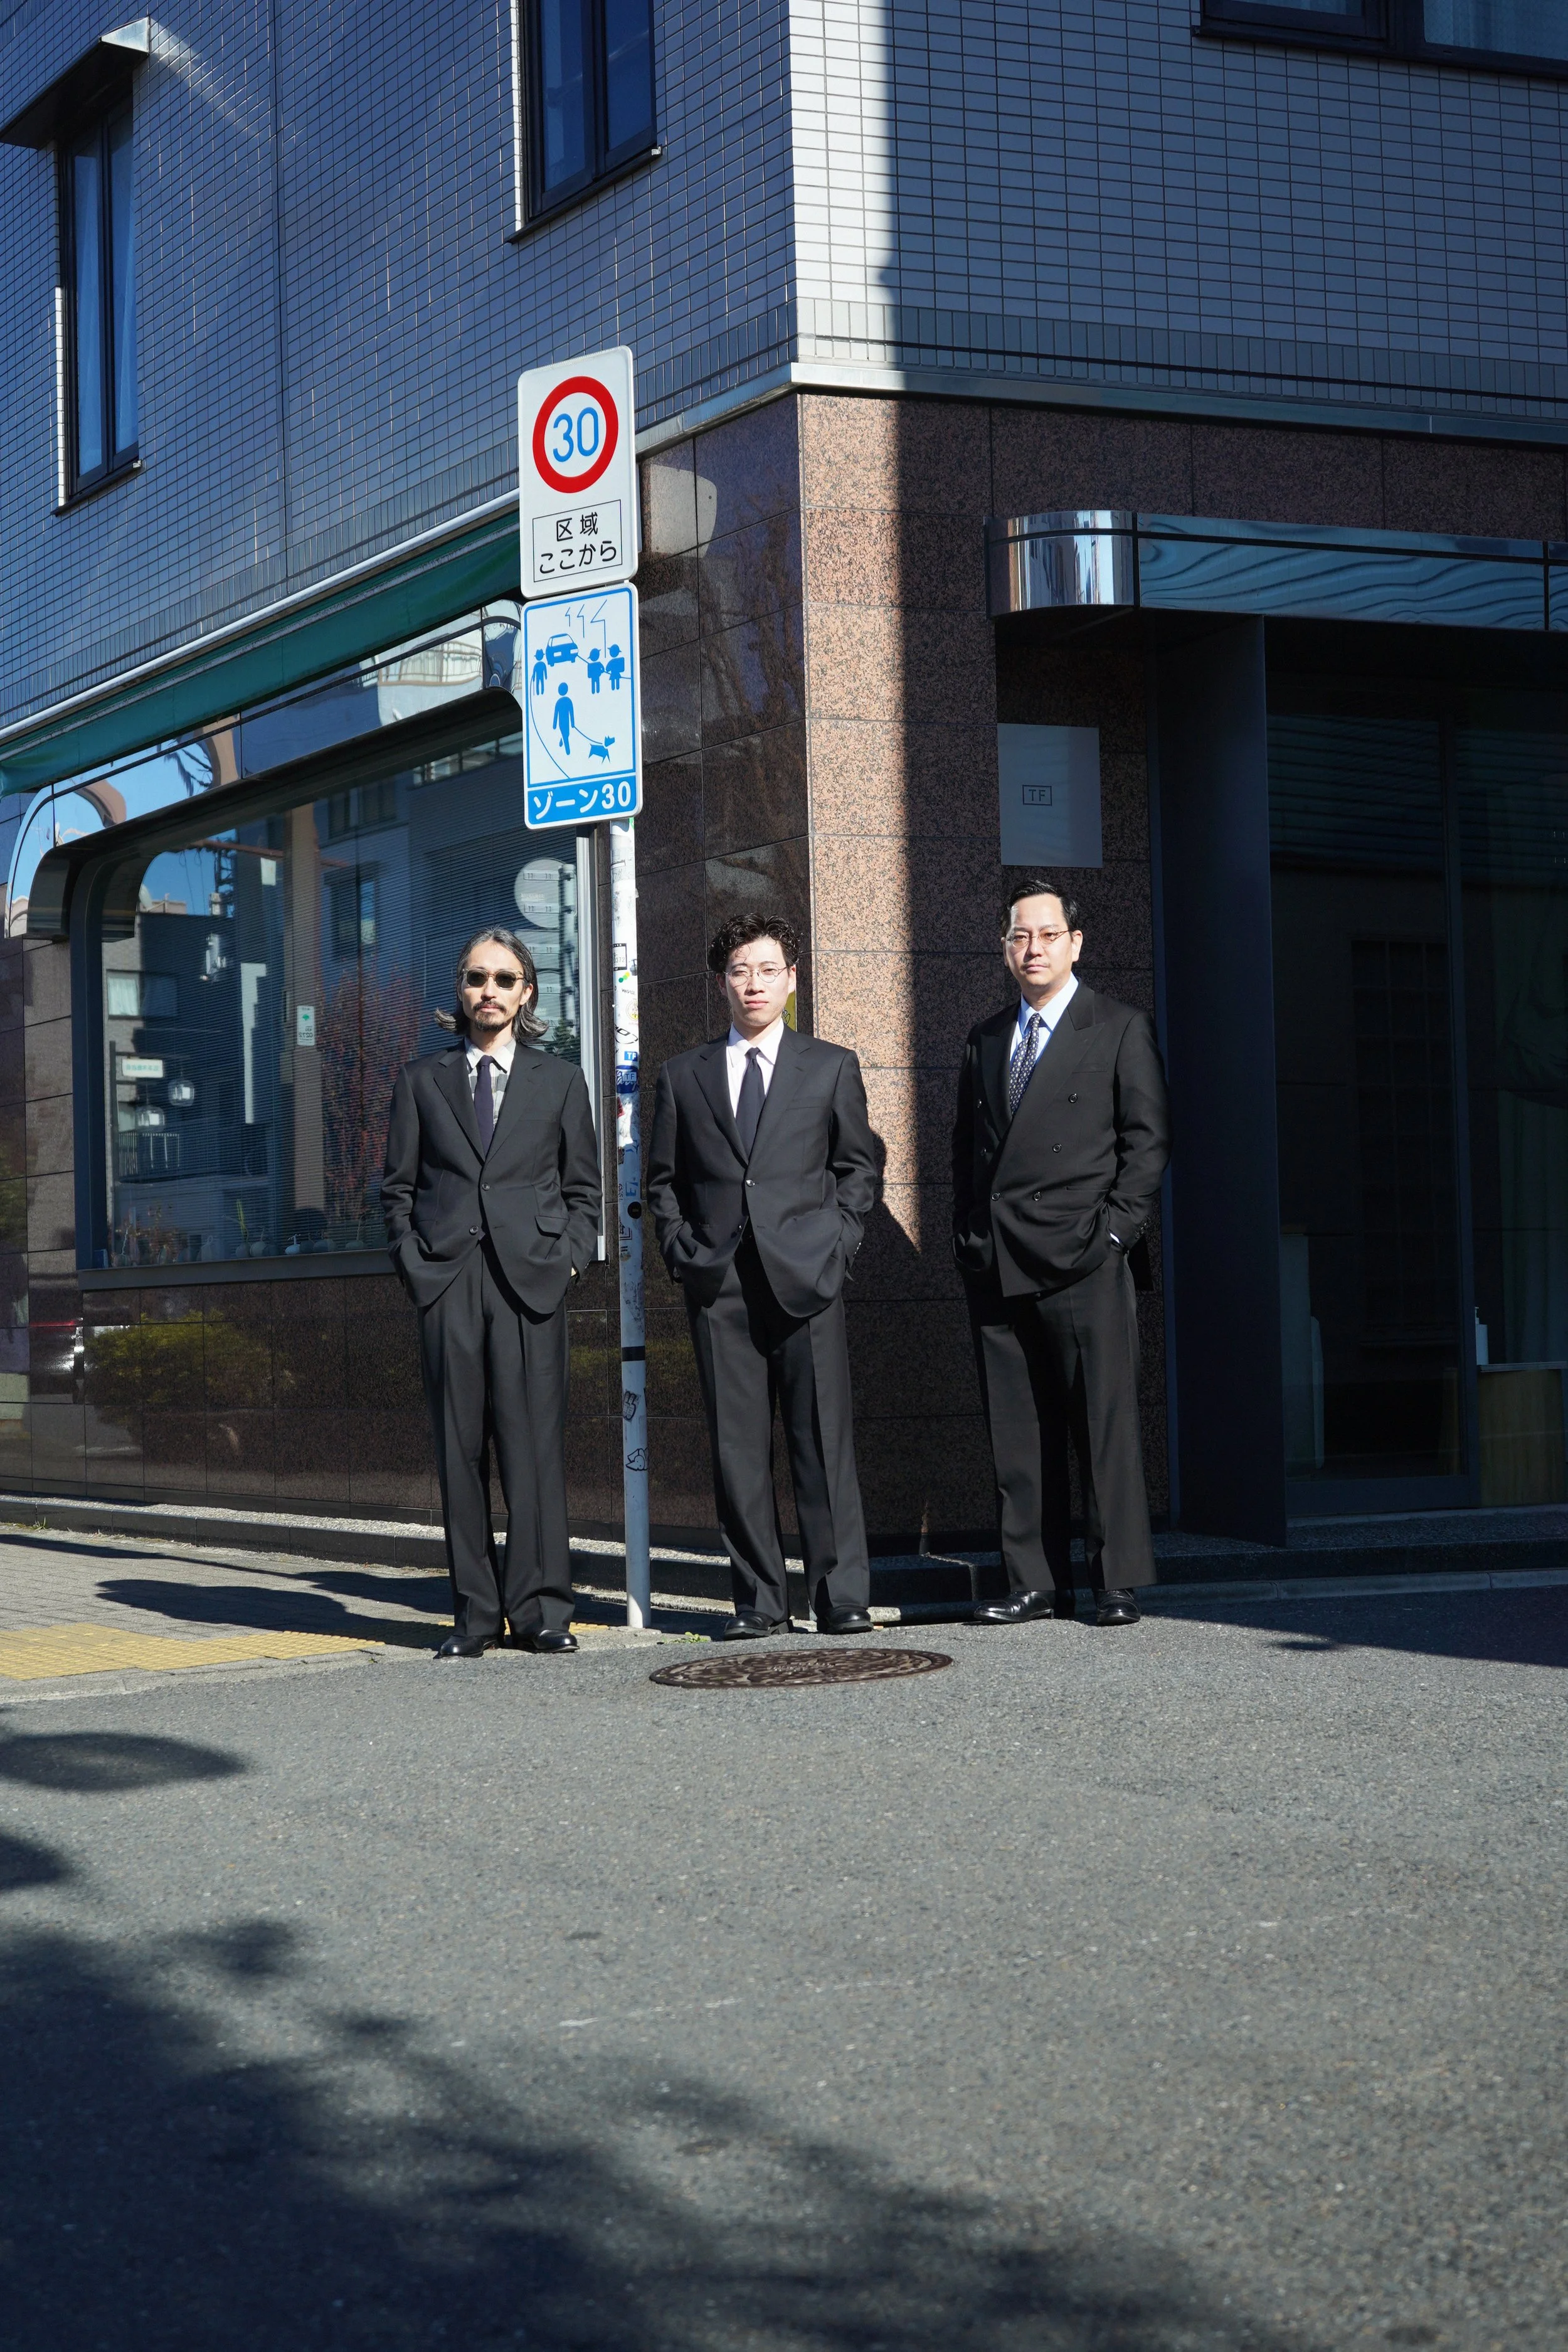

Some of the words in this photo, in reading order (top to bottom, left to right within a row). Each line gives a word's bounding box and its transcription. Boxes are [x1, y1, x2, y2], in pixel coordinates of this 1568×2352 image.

[553, 407, 599, 462] 30
[556, 512, 598, 541] 区域
[540, 541, 617, 574] ここから
[534, 781, 631, 820] ゾーン30
[1028, 789, 1046, 802] TF
[627, 1052, 637, 1060] TF
